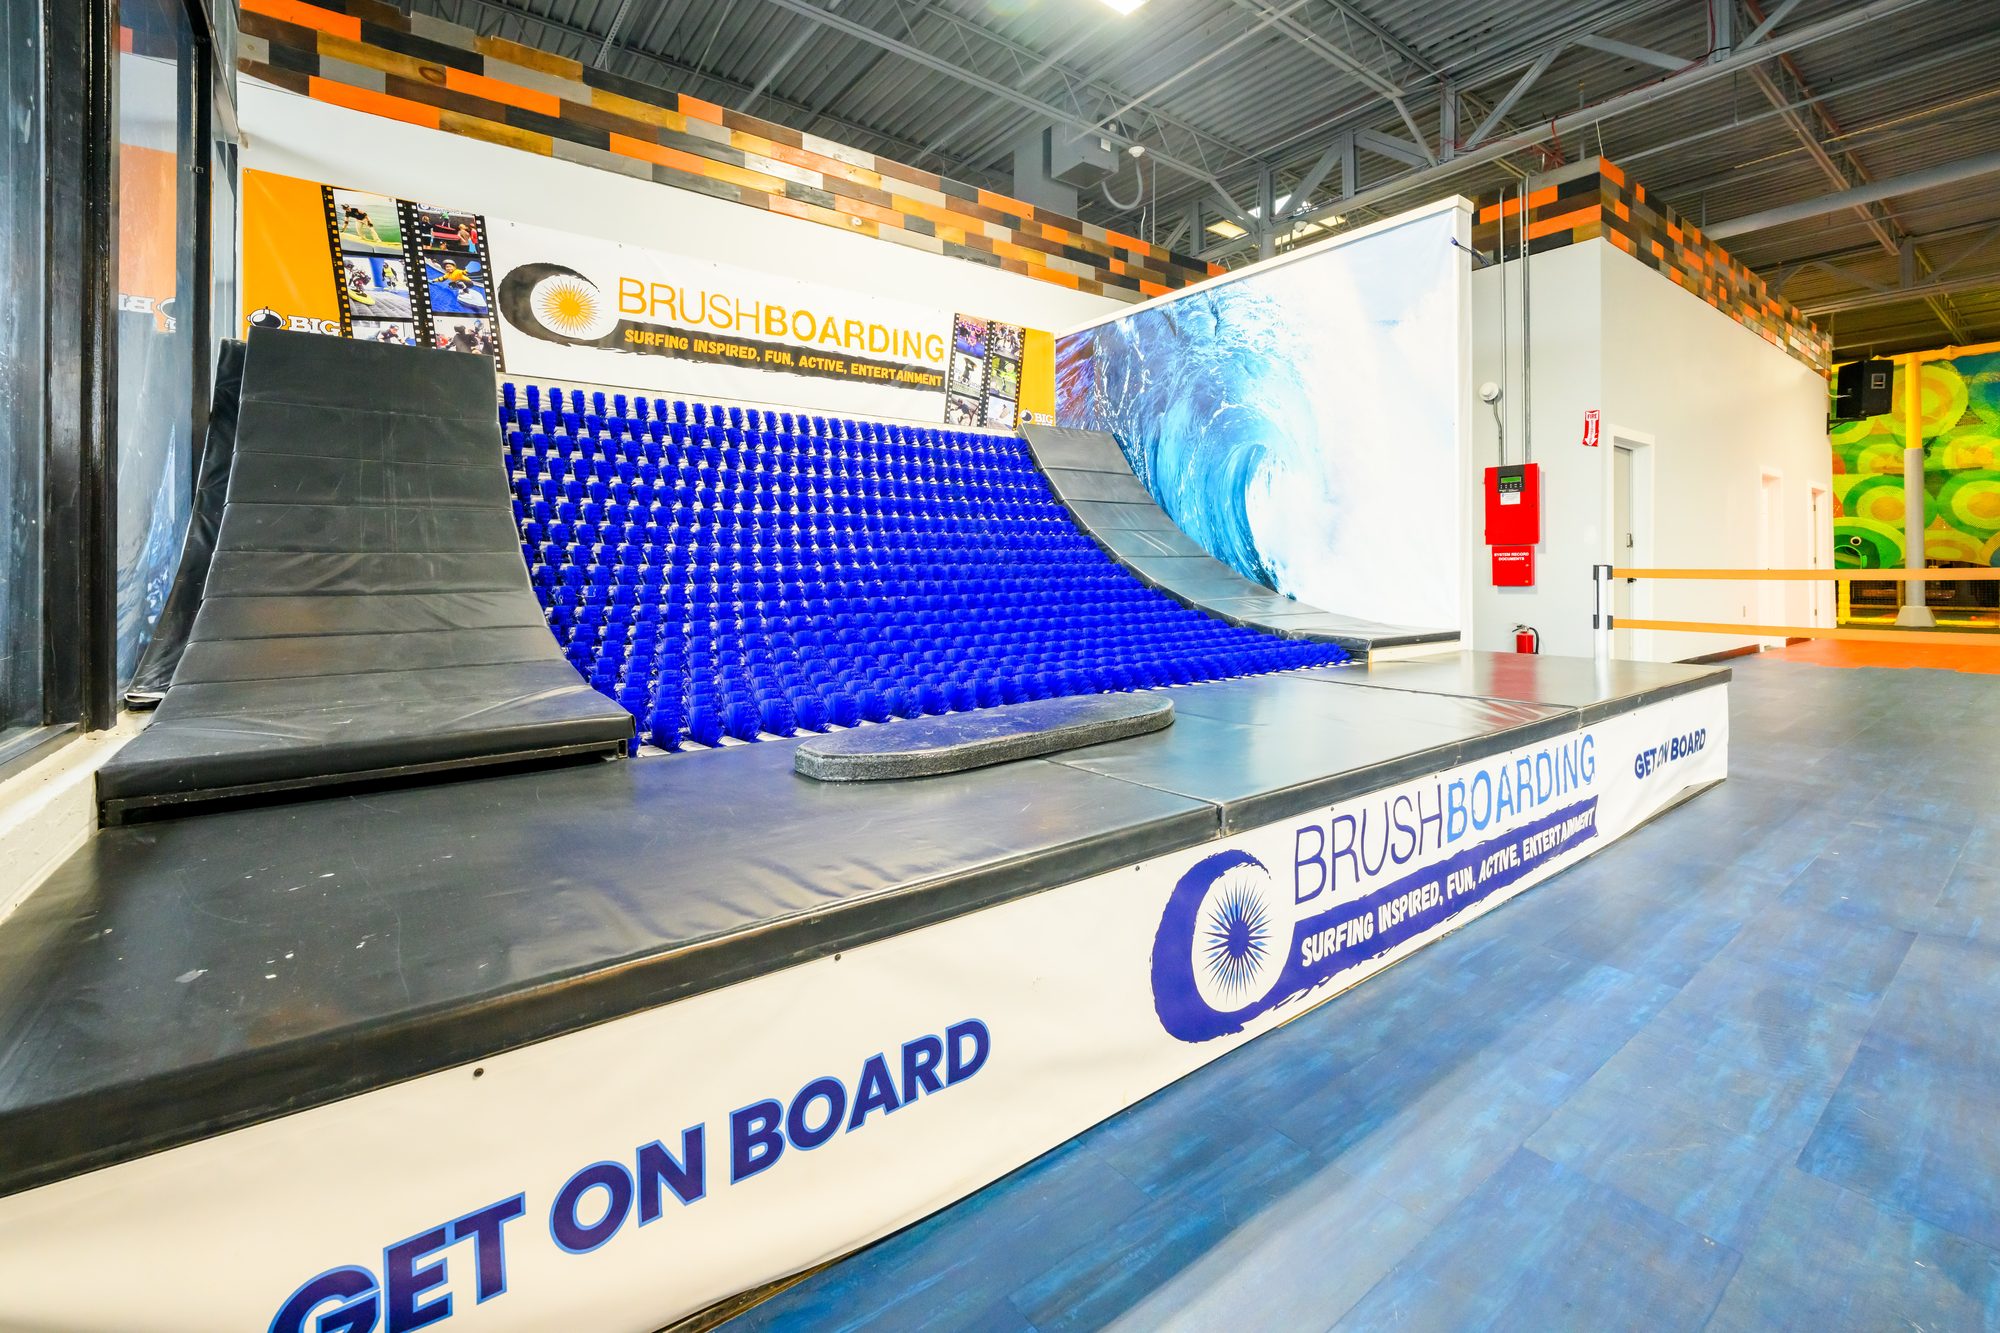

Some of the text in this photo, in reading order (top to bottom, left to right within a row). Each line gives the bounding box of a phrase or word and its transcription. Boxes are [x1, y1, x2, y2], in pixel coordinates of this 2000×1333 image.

[287, 315, 341, 337] BIG
[618, 276, 944, 363] BRUSHBOARDING
[624, 329, 943, 387] SURFING INSPIRED, FUN, ACTIVE, ENTERTAINMENT
[1034, 412, 1054, 425] BIG
[1634, 747, 1657, 779] GET
[1670, 728, 1706, 761] BOARD
[1295, 733, 1595, 906] BRUSHBOARDING
[1301, 806, 1596, 968] SURFING INSPIRED, FUN, ACTIVE, ENTERTAINMENT
[266, 1017, 991, 1333] GET ON BOARD
